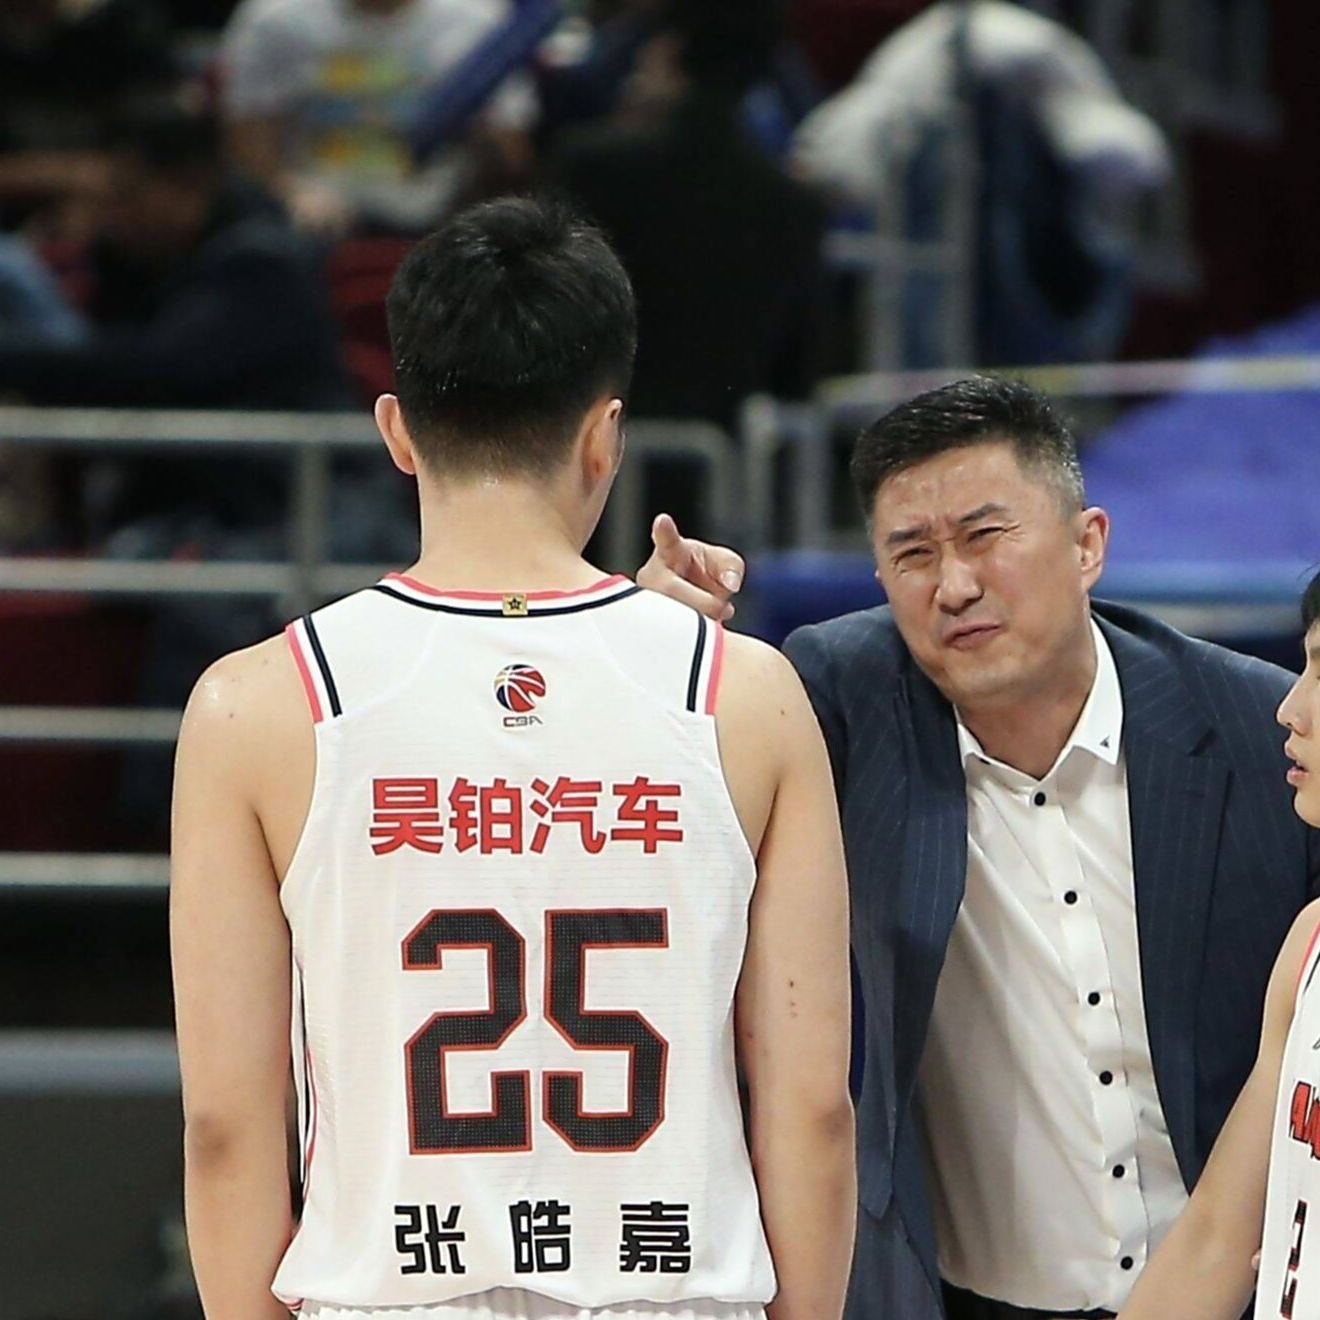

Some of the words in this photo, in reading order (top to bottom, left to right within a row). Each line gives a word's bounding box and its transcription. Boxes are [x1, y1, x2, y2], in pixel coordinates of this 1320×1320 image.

[502, 716, 543, 728] CBA
[369, 776, 683, 856] 昊铂汽车
[401, 908, 670, 1155] 25
[394, 1200, 691, 1274] 张皓嘉
